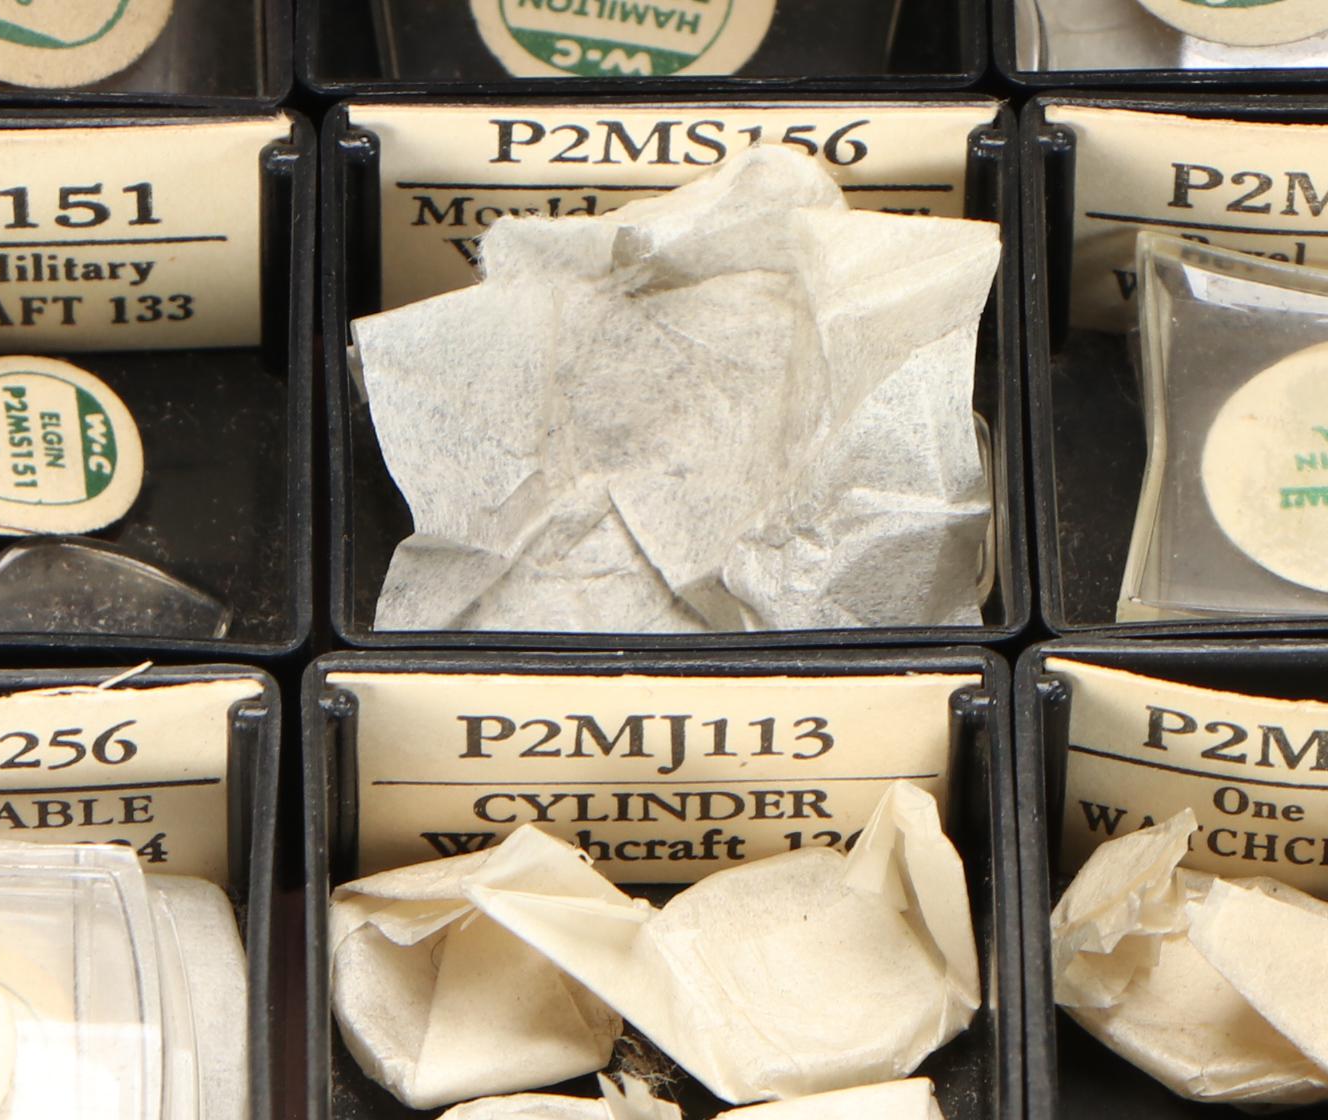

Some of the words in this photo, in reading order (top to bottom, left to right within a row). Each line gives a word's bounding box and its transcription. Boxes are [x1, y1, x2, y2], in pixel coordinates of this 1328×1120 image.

[489, 119, 871, 166] P2MS156
[110, 295, 196, 323] 133
[2, 386, 38, 488] P2MS151
[40, 411, 66, 469] ELGIN
[1296, 454, 1328, 471] IN
[456, 715, 835, 775] P2MJ113
[473, 790, 832, 823] CYLINDER
[1211, 787, 1304, 822] One
[421, 829, 745, 861] Whcraft
